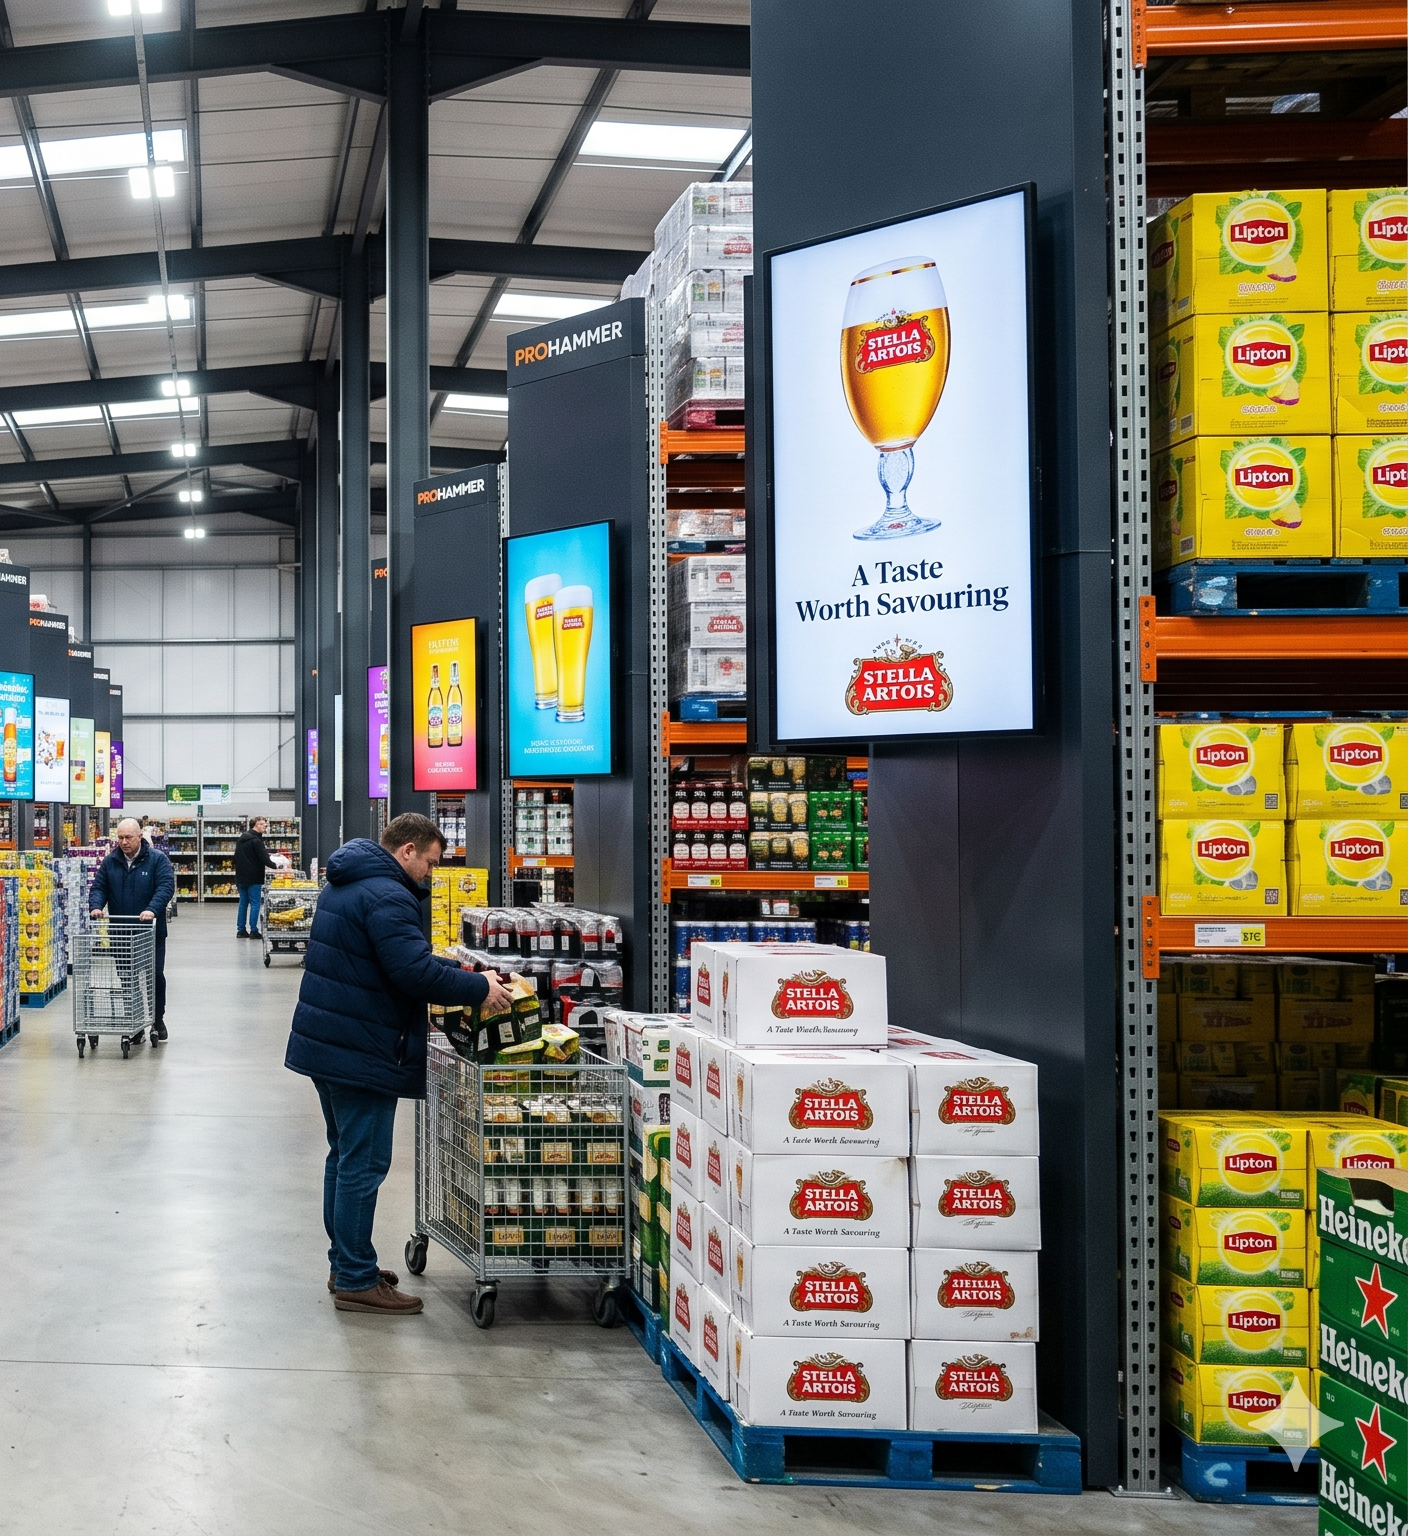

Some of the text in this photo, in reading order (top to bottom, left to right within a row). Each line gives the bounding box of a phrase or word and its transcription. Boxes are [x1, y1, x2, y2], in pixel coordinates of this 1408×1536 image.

[1235, 226, 1284, 241] Lipton
[515, 321, 622, 366] PROHAMMER
[868, 329, 920, 350] STELLA
[867, 342, 921, 363] ARTOIS
[1237, 348, 1286, 363] Lipton
[1239, 470, 1288, 485] Lipton
[418, 479, 485, 505] PROHAMMER
[852, 559, 943, 586] A Taste
[796, 584, 1009, 622] Worth Savouring
[864, 668, 934, 685] STELLA
[863, 684, 934, 701] ARTOIS
[1199, 749, 1244, 762] Lipton
[1333, 748, 1378, 761] Lipton
[1201, 843, 1245, 856] Lipton
[1334, 843, 1379, 856] Lipton
[786, 988, 838, 999] STELLA
[786, 1000, 839, 1011] ARTOIS
[805, 1099, 857, 1109] STELLA
[953, 1096, 1002, 1105] STELLA
[804, 1110, 859, 1121] ARTOIS
[952, 1106, 1002, 1116] ARTOIS
[1229, 1157, 1272, 1171] Lipton
[1347, 1159, 1390, 1169] Lipton
[805, 1189, 858, 1199] STELLA
[953, 1189, 1002, 1199] STELLA
[805, 1201, 859, 1211] ARTOIS
[952, 1200, 1002, 1209] ARTOIS
[1228, 1237, 1272, 1251] Lipton
[805, 1281, 858, 1291] STELLA
[805, 1293, 859, 1303] ARTOIS
[952, 1290, 1002, 1300] ARTOIS
[1232, 1315, 1276, 1328] Lipton
[802, 1371, 855, 1382] STELLA
[950, 1372, 999, 1381] STELLA
[802, 1383, 856, 1394] ARTOIS
[949, 1383, 1000, 1392] ARTOIS
[1233, 1395, 1276, 1408] Lipton
